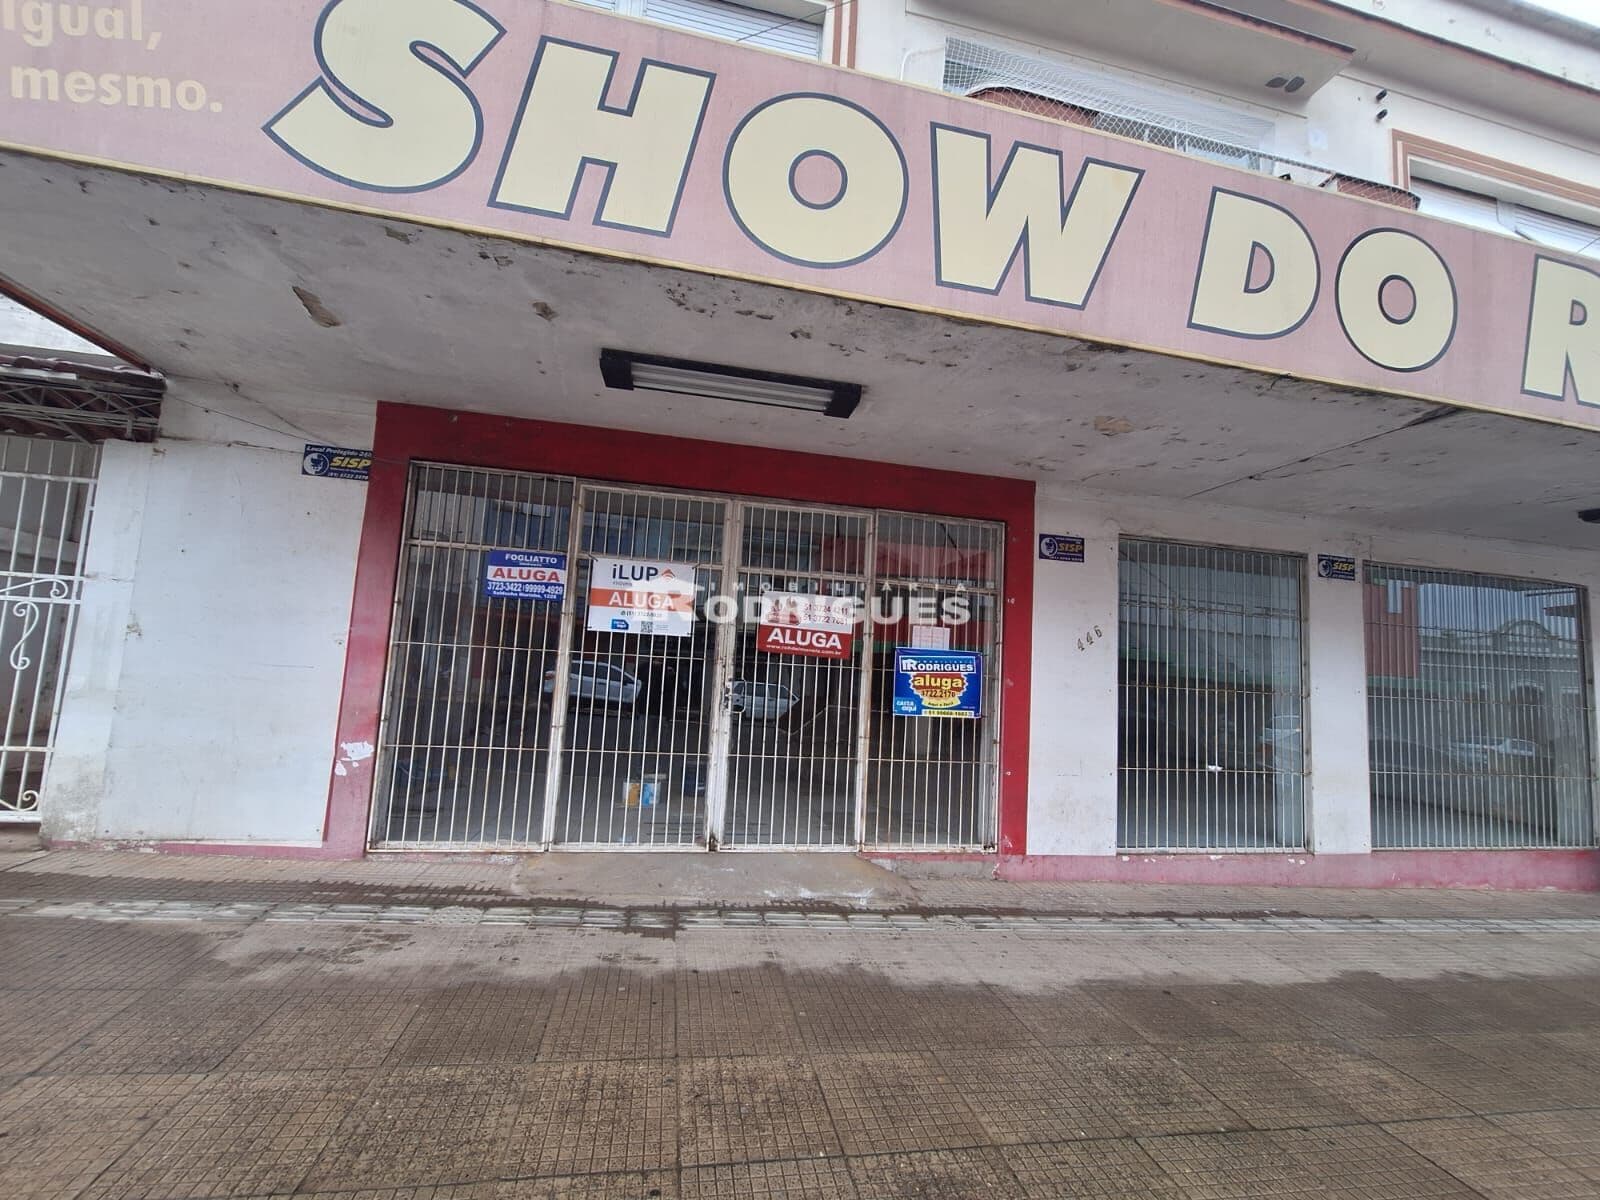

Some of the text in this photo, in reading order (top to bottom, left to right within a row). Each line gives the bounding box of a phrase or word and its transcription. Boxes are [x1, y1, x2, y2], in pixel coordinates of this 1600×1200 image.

[11, 65, 223, 112] mesmo.
[262, 0, 1146, 310] SHOW
[1187, 186, 1458, 373] DO
[330, 456, 372, 468] SISP
[1059, 543, 1083, 552] SISP
[505, 553, 557, 564] FOGLIATTO
[493, 567, 560, 582] ALUGA
[612, 564, 658, 581] iLUP
[608, 591, 674, 609] ALUGA
[766, 627, 842, 650] ALUGA
[1077, 624, 1103, 652] 446
[914, 674, 962, 690] aluga
